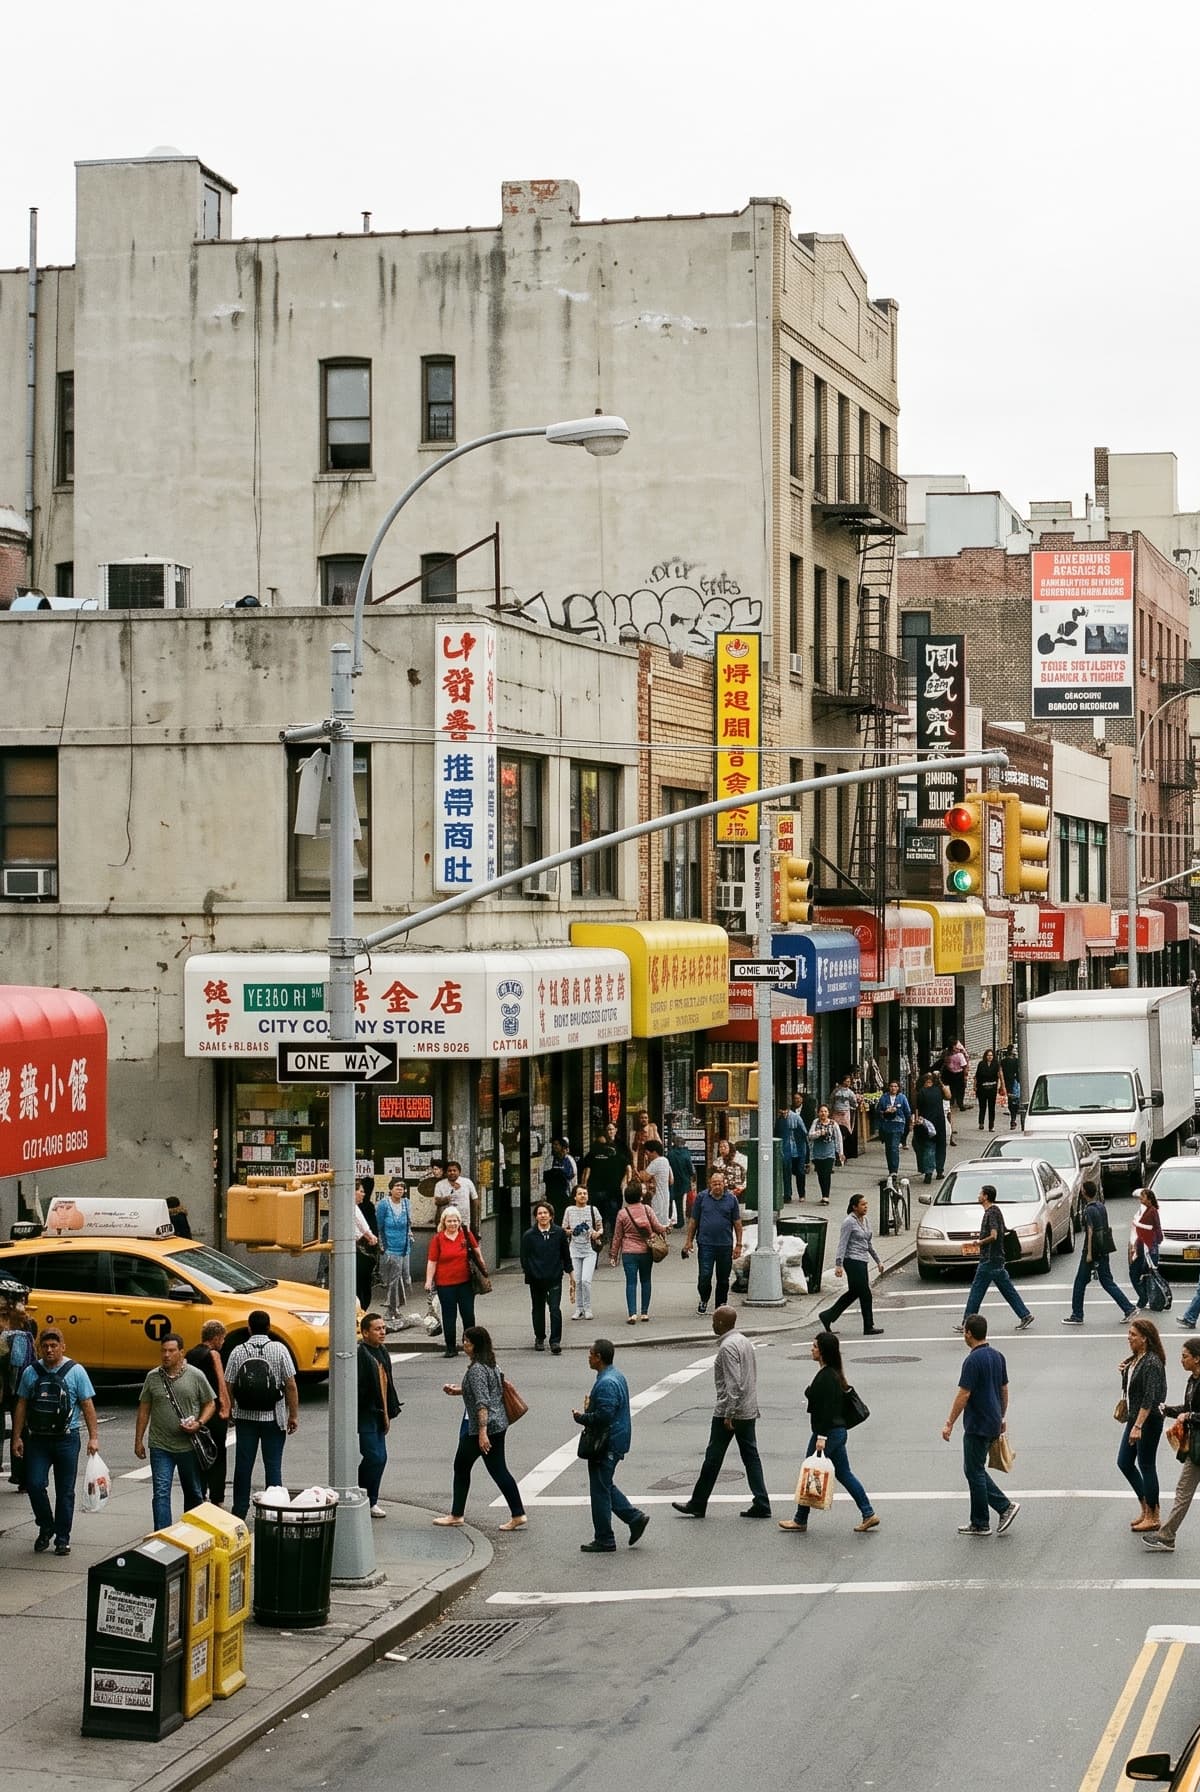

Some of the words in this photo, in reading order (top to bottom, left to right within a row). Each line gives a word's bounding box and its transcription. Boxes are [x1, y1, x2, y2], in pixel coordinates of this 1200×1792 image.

[258, 1019, 298, 1035] CITY
[383, 1019, 446, 1035] STORE
[294, 1054, 330, 1070] ONE
[344, 1054, 380, 1070] WAY
[149, 1318, 166, 1340] T
